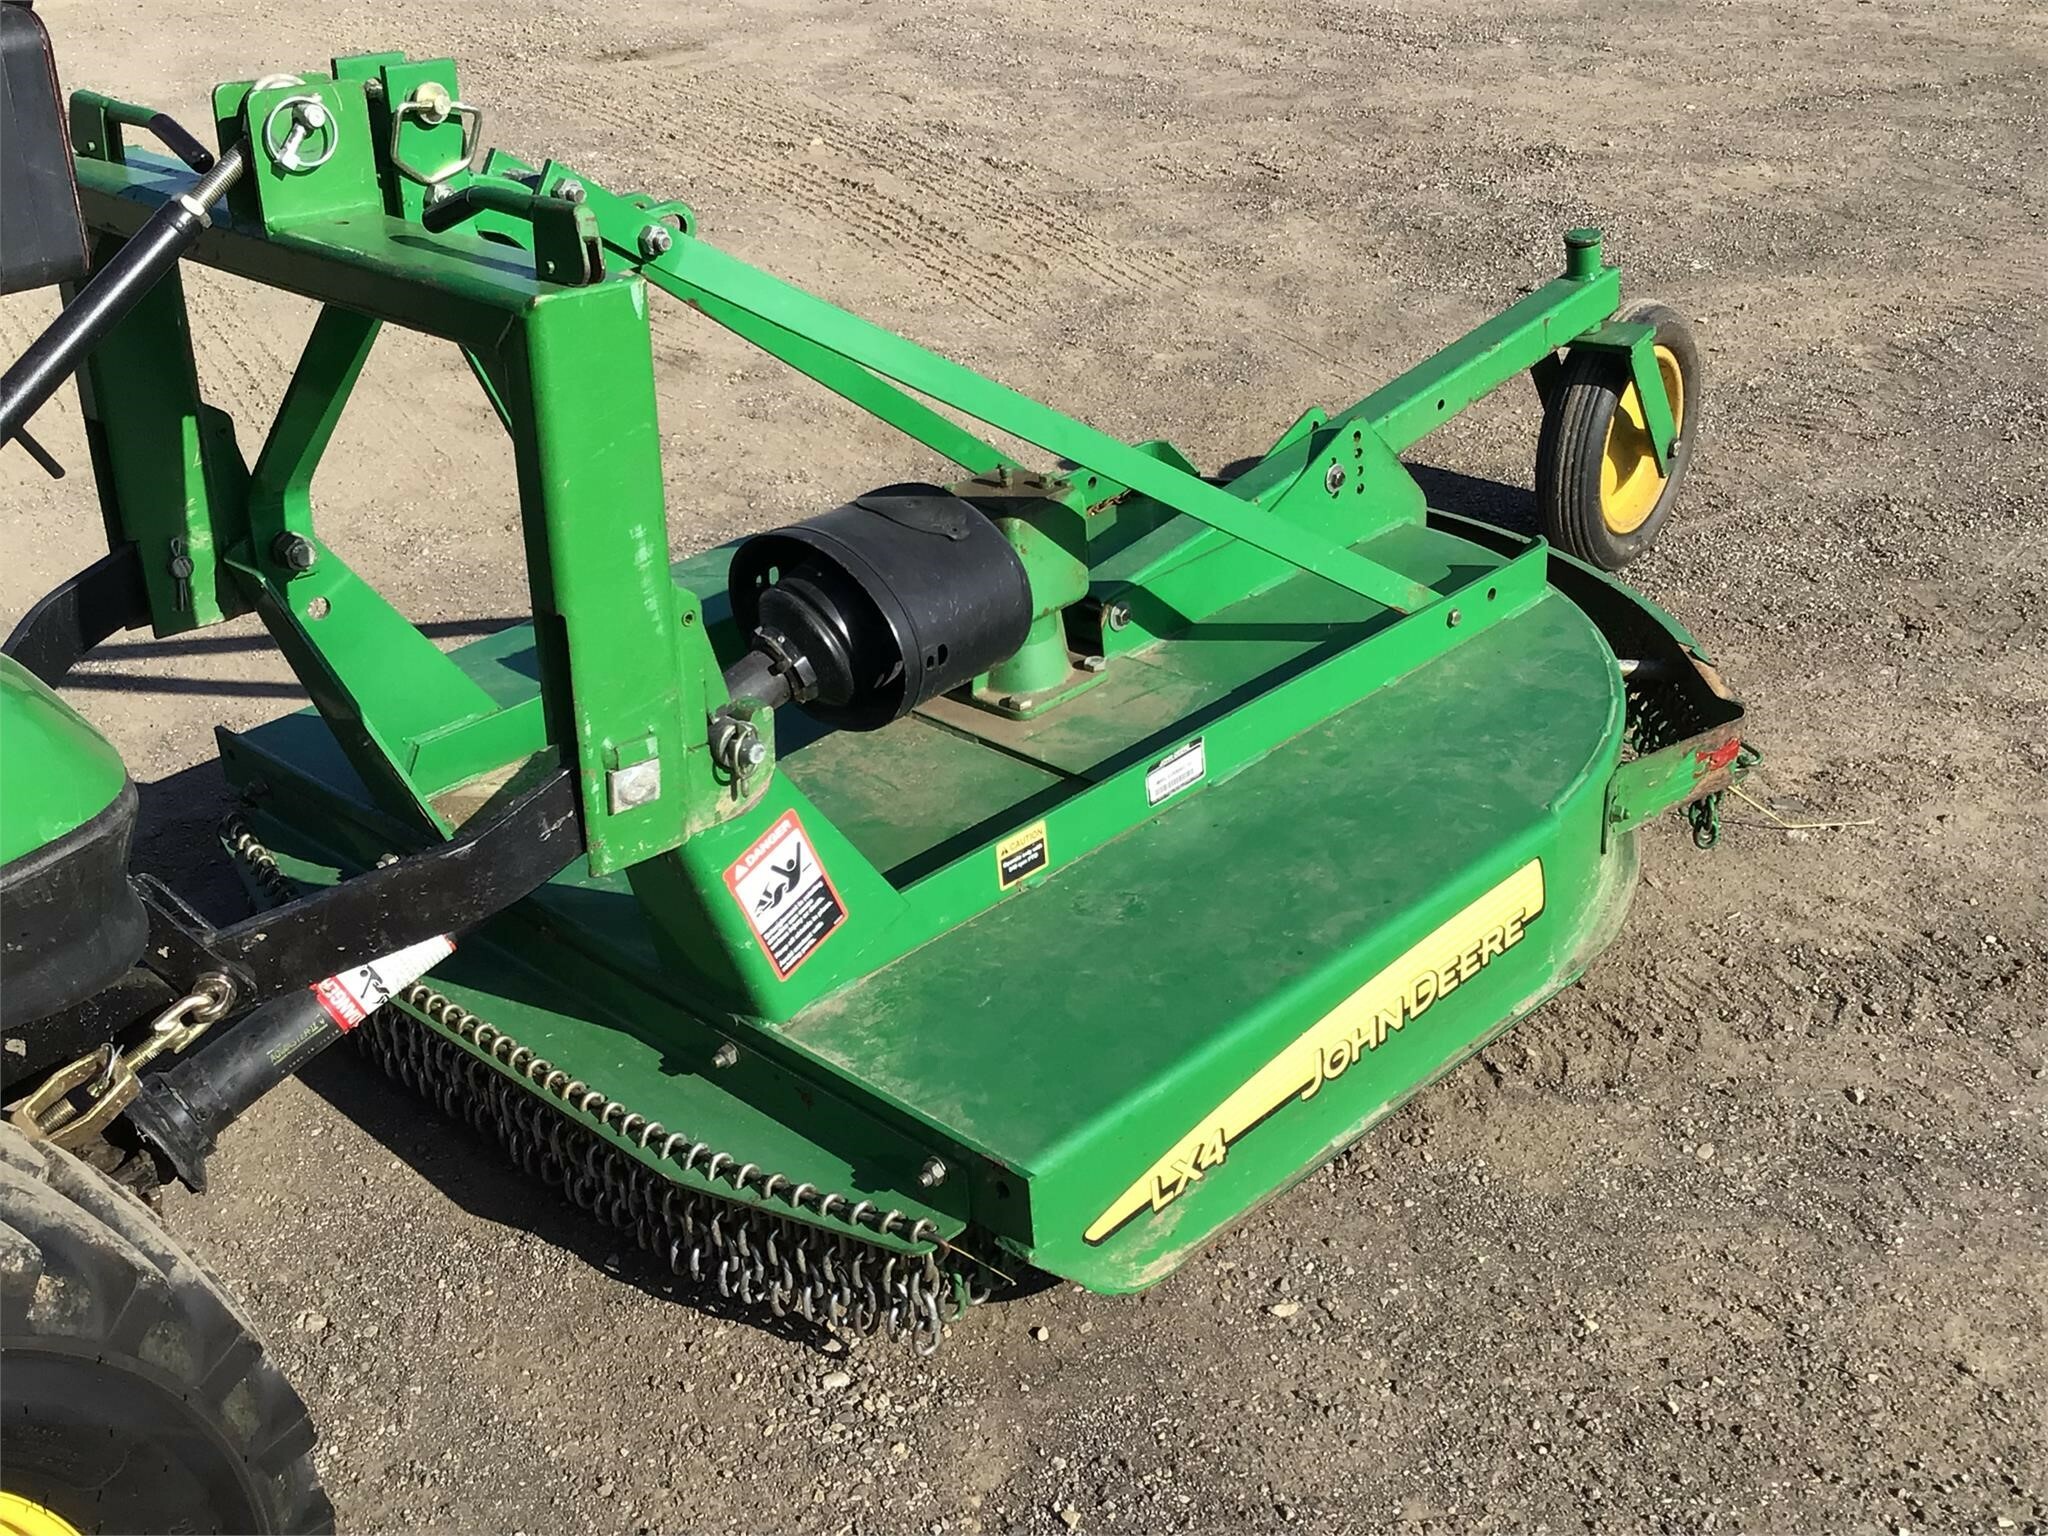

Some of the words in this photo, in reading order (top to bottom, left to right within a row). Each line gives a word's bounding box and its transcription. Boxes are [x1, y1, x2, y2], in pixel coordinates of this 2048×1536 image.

[745, 819, 792, 867] DANGER
[1010, 827, 1043, 850] CAUTION
[319, 977, 365, 1027] DANGER
[1301, 996, 1404, 1101] JOHN
[1409, 907, 1526, 1020] DEERE
[1150, 1127, 1228, 1213] LX4
